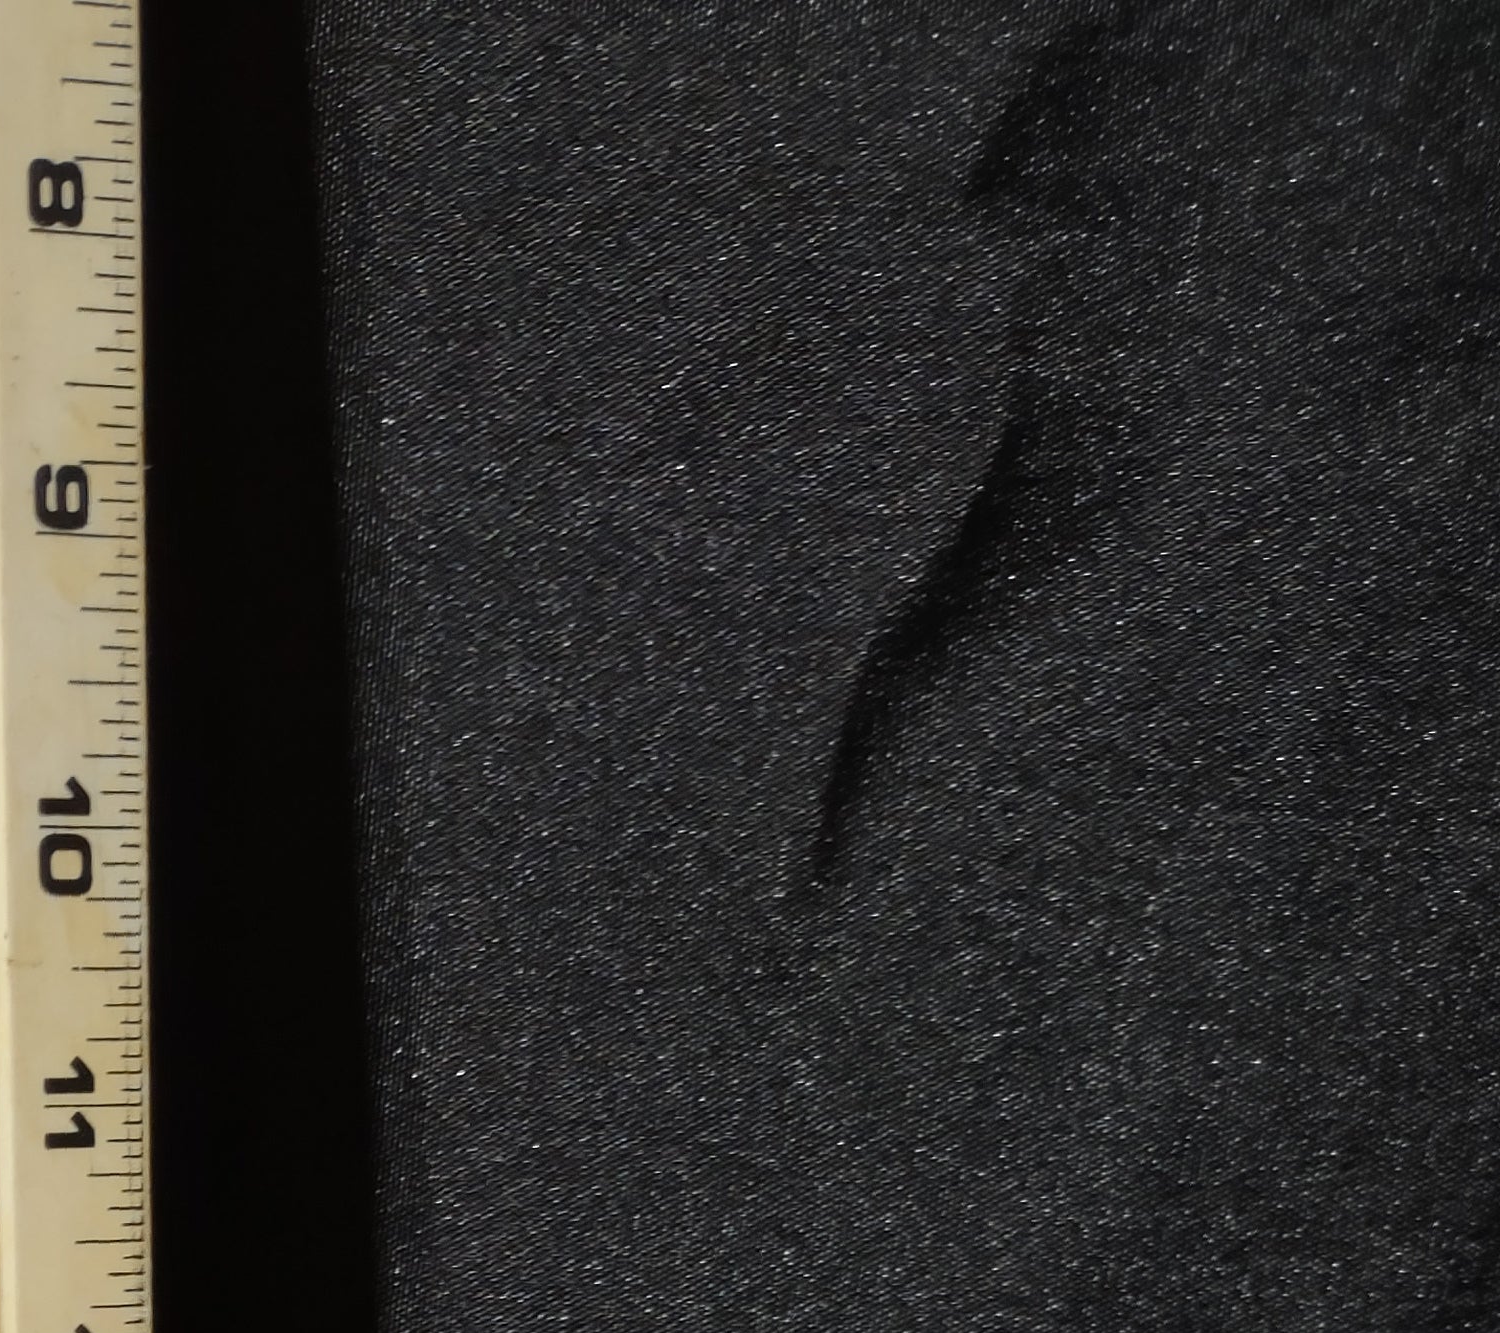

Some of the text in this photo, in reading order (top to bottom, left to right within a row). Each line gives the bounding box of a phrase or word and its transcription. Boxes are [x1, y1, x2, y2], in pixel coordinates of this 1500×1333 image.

[28, 158, 84, 228] 8
[34, 464, 90, 531] 9
[38, 776, 93, 896] 10
[43, 1056, 96, 1150] 11
